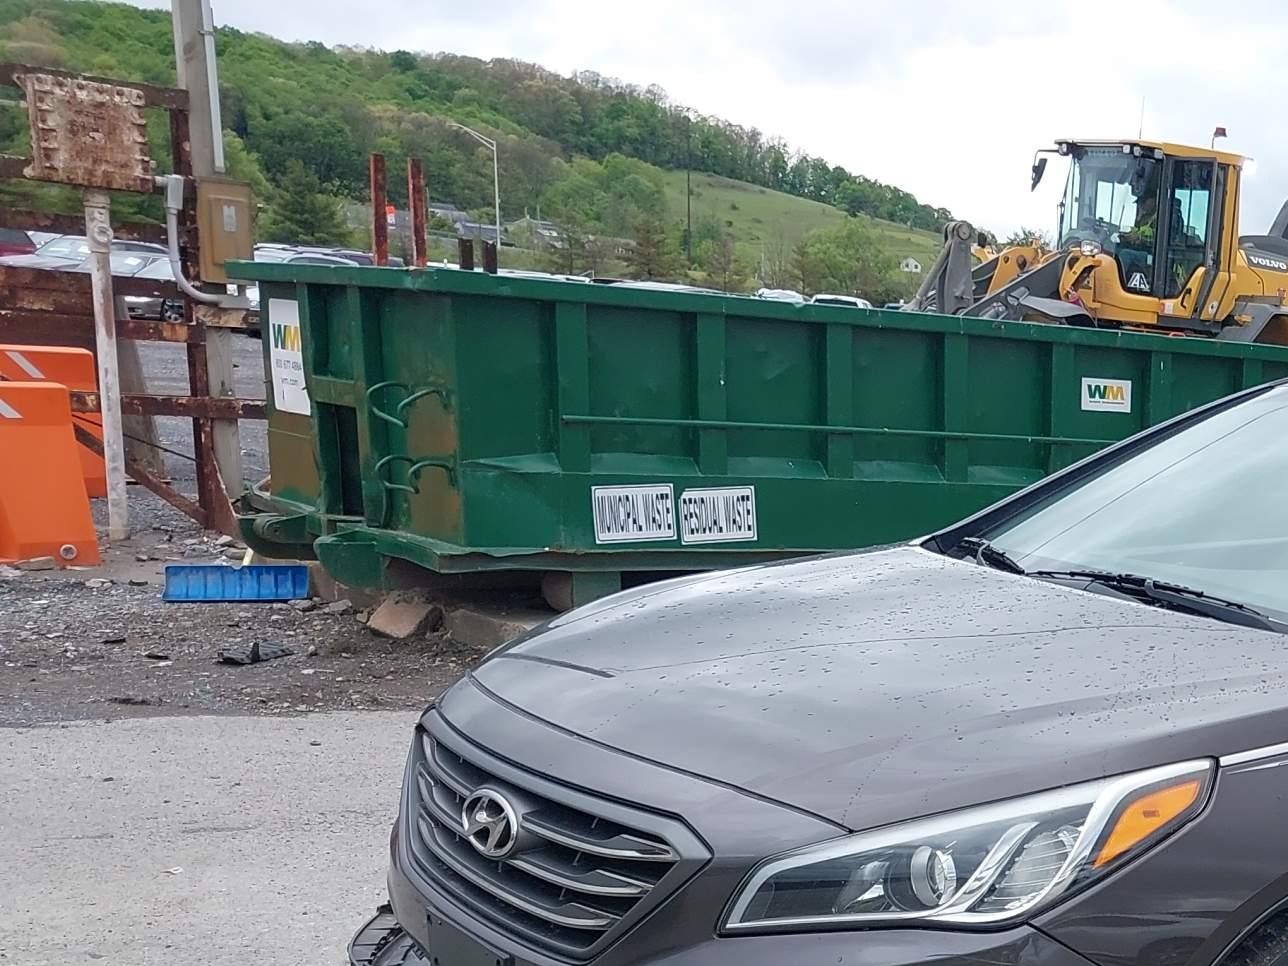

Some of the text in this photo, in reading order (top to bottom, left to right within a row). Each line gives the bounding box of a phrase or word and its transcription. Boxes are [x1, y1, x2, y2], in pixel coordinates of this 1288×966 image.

[1249, 256, 1287, 270] VOLVO
[272, 323, 301, 352] WM
[1087, 384, 1125, 400] WM
[597, 492, 672, 534] MUNICIPAL WASTE
[682, 494, 752, 536] RESIDUAL WASTE
